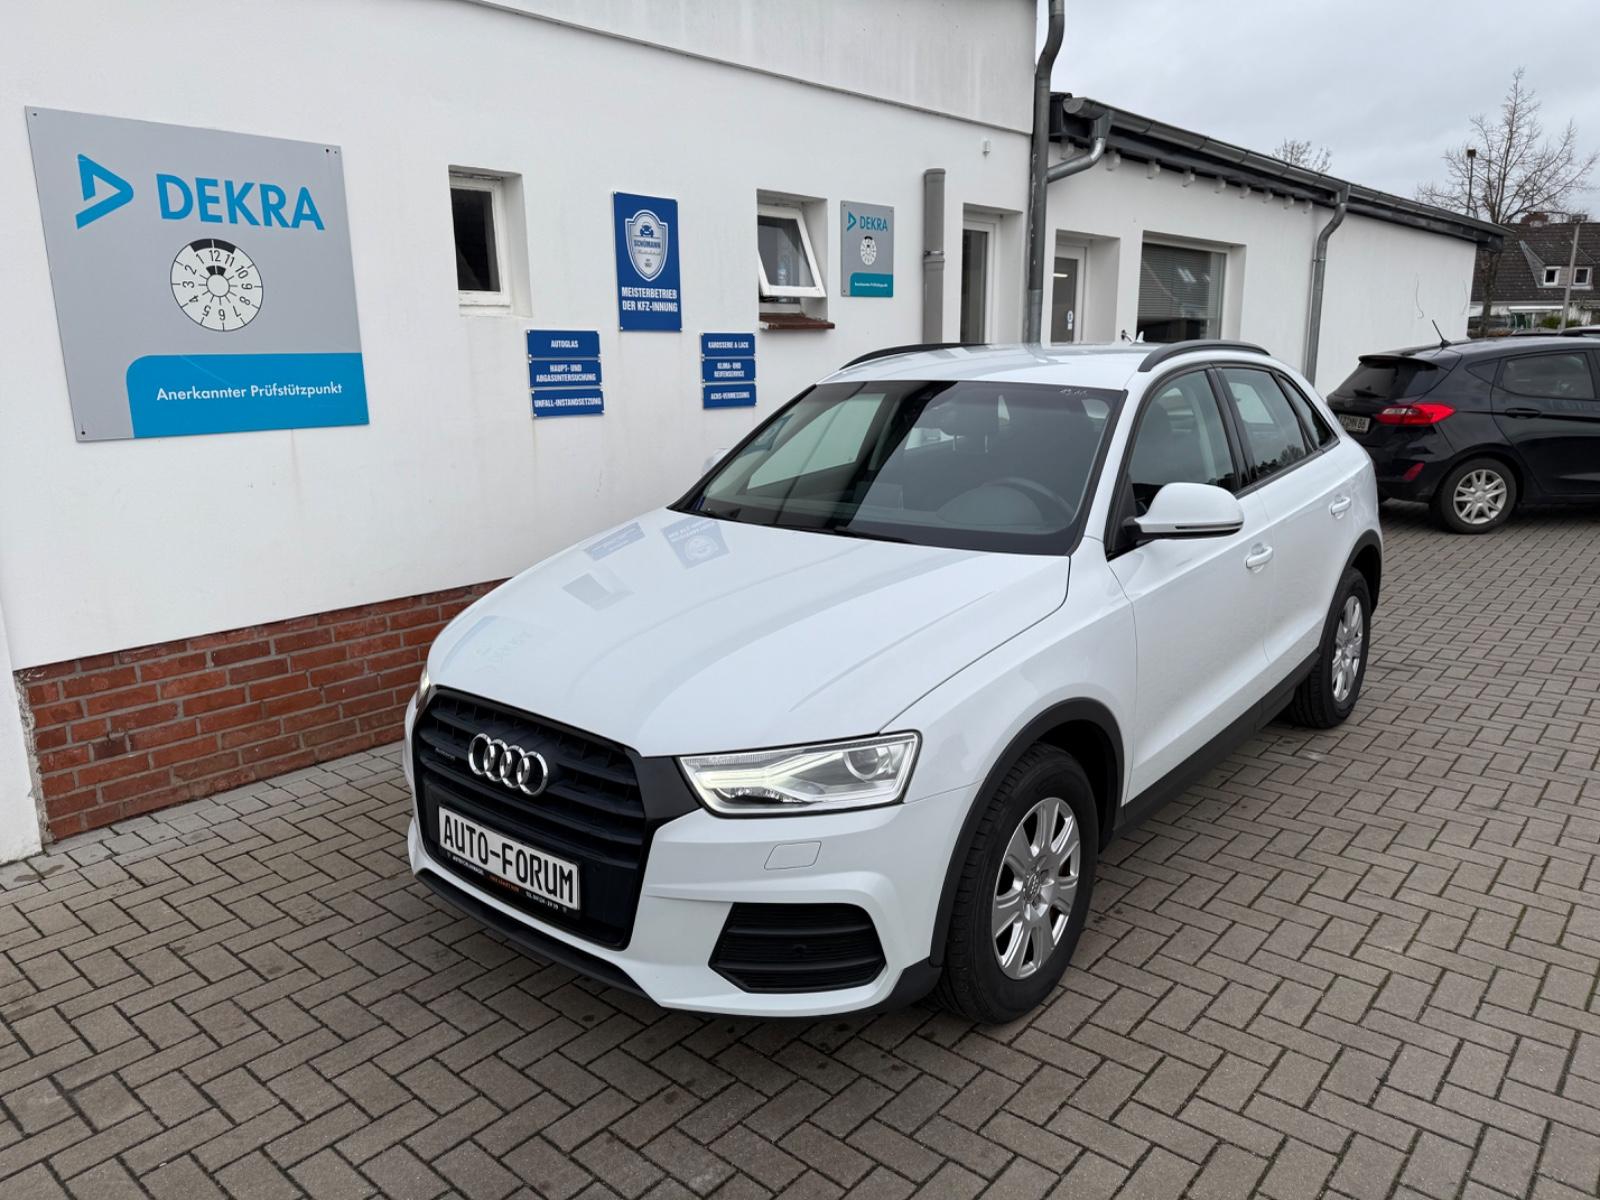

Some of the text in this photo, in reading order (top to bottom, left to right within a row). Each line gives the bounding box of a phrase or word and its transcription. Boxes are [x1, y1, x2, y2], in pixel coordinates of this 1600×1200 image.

[156, 173, 325, 231] DEKRA
[859, 215, 888, 232] DEKRA
[195, 253, 205, 265] 1
[209, 249, 221, 262] 12
[225, 254, 235, 267] 11
[184, 264, 197, 275] 2
[235, 265, 249, 279] 10
[182, 280, 195, 289] 3
[189, 294, 199, 303] 4
[621, 286, 677, 299] MEISTERBETRIEB
[239, 296, 251, 306] 8
[622, 300, 678, 312] DER KFZ-INNUNG
[202, 304, 211, 317] 5
[218, 308, 226, 321] 6
[232, 305, 241, 317] 7
[551, 340, 578, 348] AUTOGLAS
[570, 364, 582, 373] UND
[536, 373, 596, 382] ABGASUNTERSUCHUNG
[156, 381, 342, 401] Anerkannter Prüfstützpunkt
[533, 397, 602, 408] UNFALL-INSTANDSETZUNG
[444, 815, 573, 904] AUTO-FORUM
